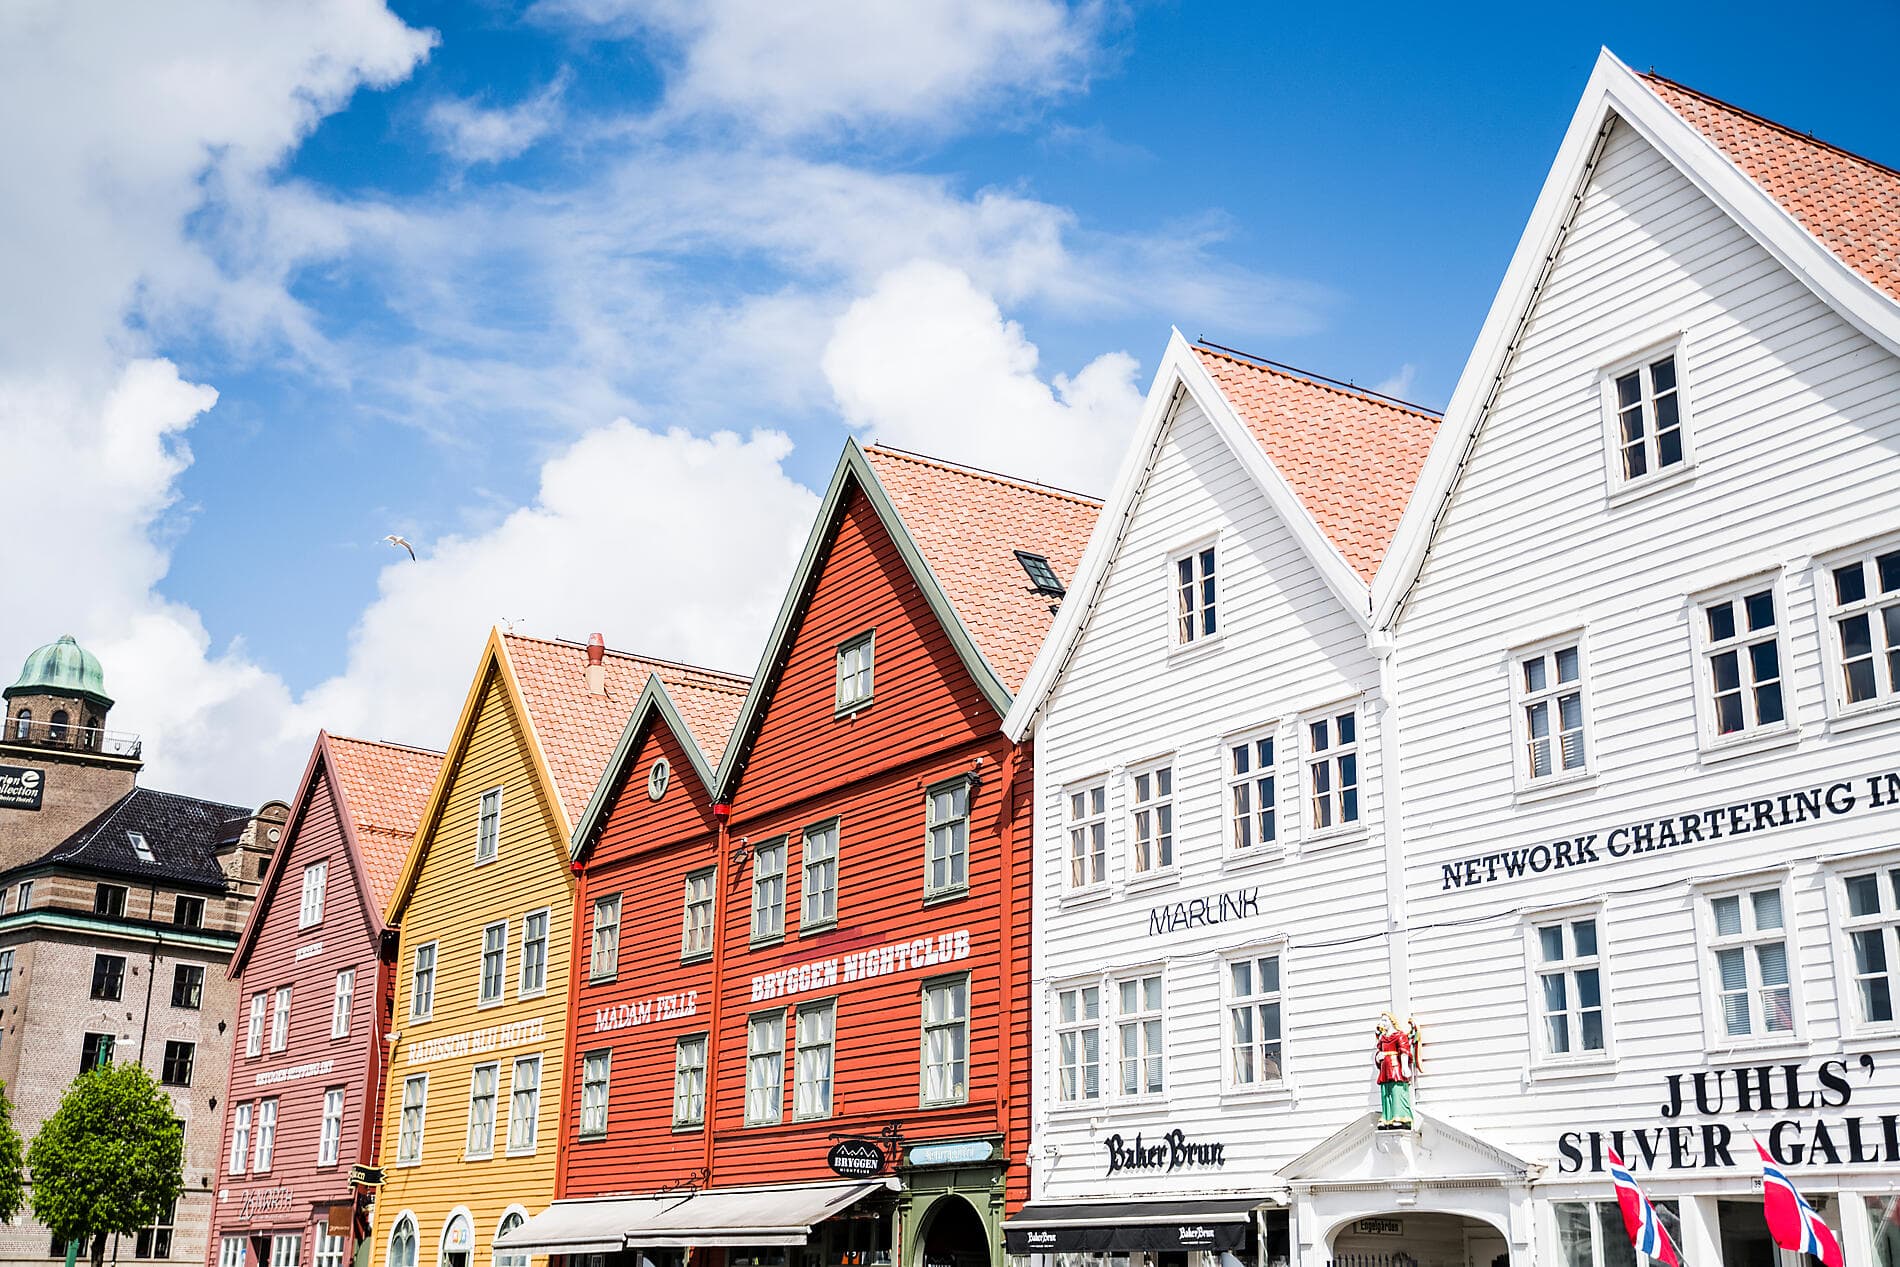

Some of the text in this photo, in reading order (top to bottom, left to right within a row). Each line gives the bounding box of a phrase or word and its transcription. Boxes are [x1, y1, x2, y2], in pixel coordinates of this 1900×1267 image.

[1441, 834, 1599, 890] NETWORK
[1607, 782, 1857, 858] CHARTERING
[1149, 886, 1259, 936] MARLINK
[751, 929, 970, 1002] BRYGGEN NIGHTCLUB
[594, 989, 698, 1032] MADAM FELLE
[834, 1157, 878, 1169] BRYGGEN
[1558, 1123, 1736, 1173] SILVER
